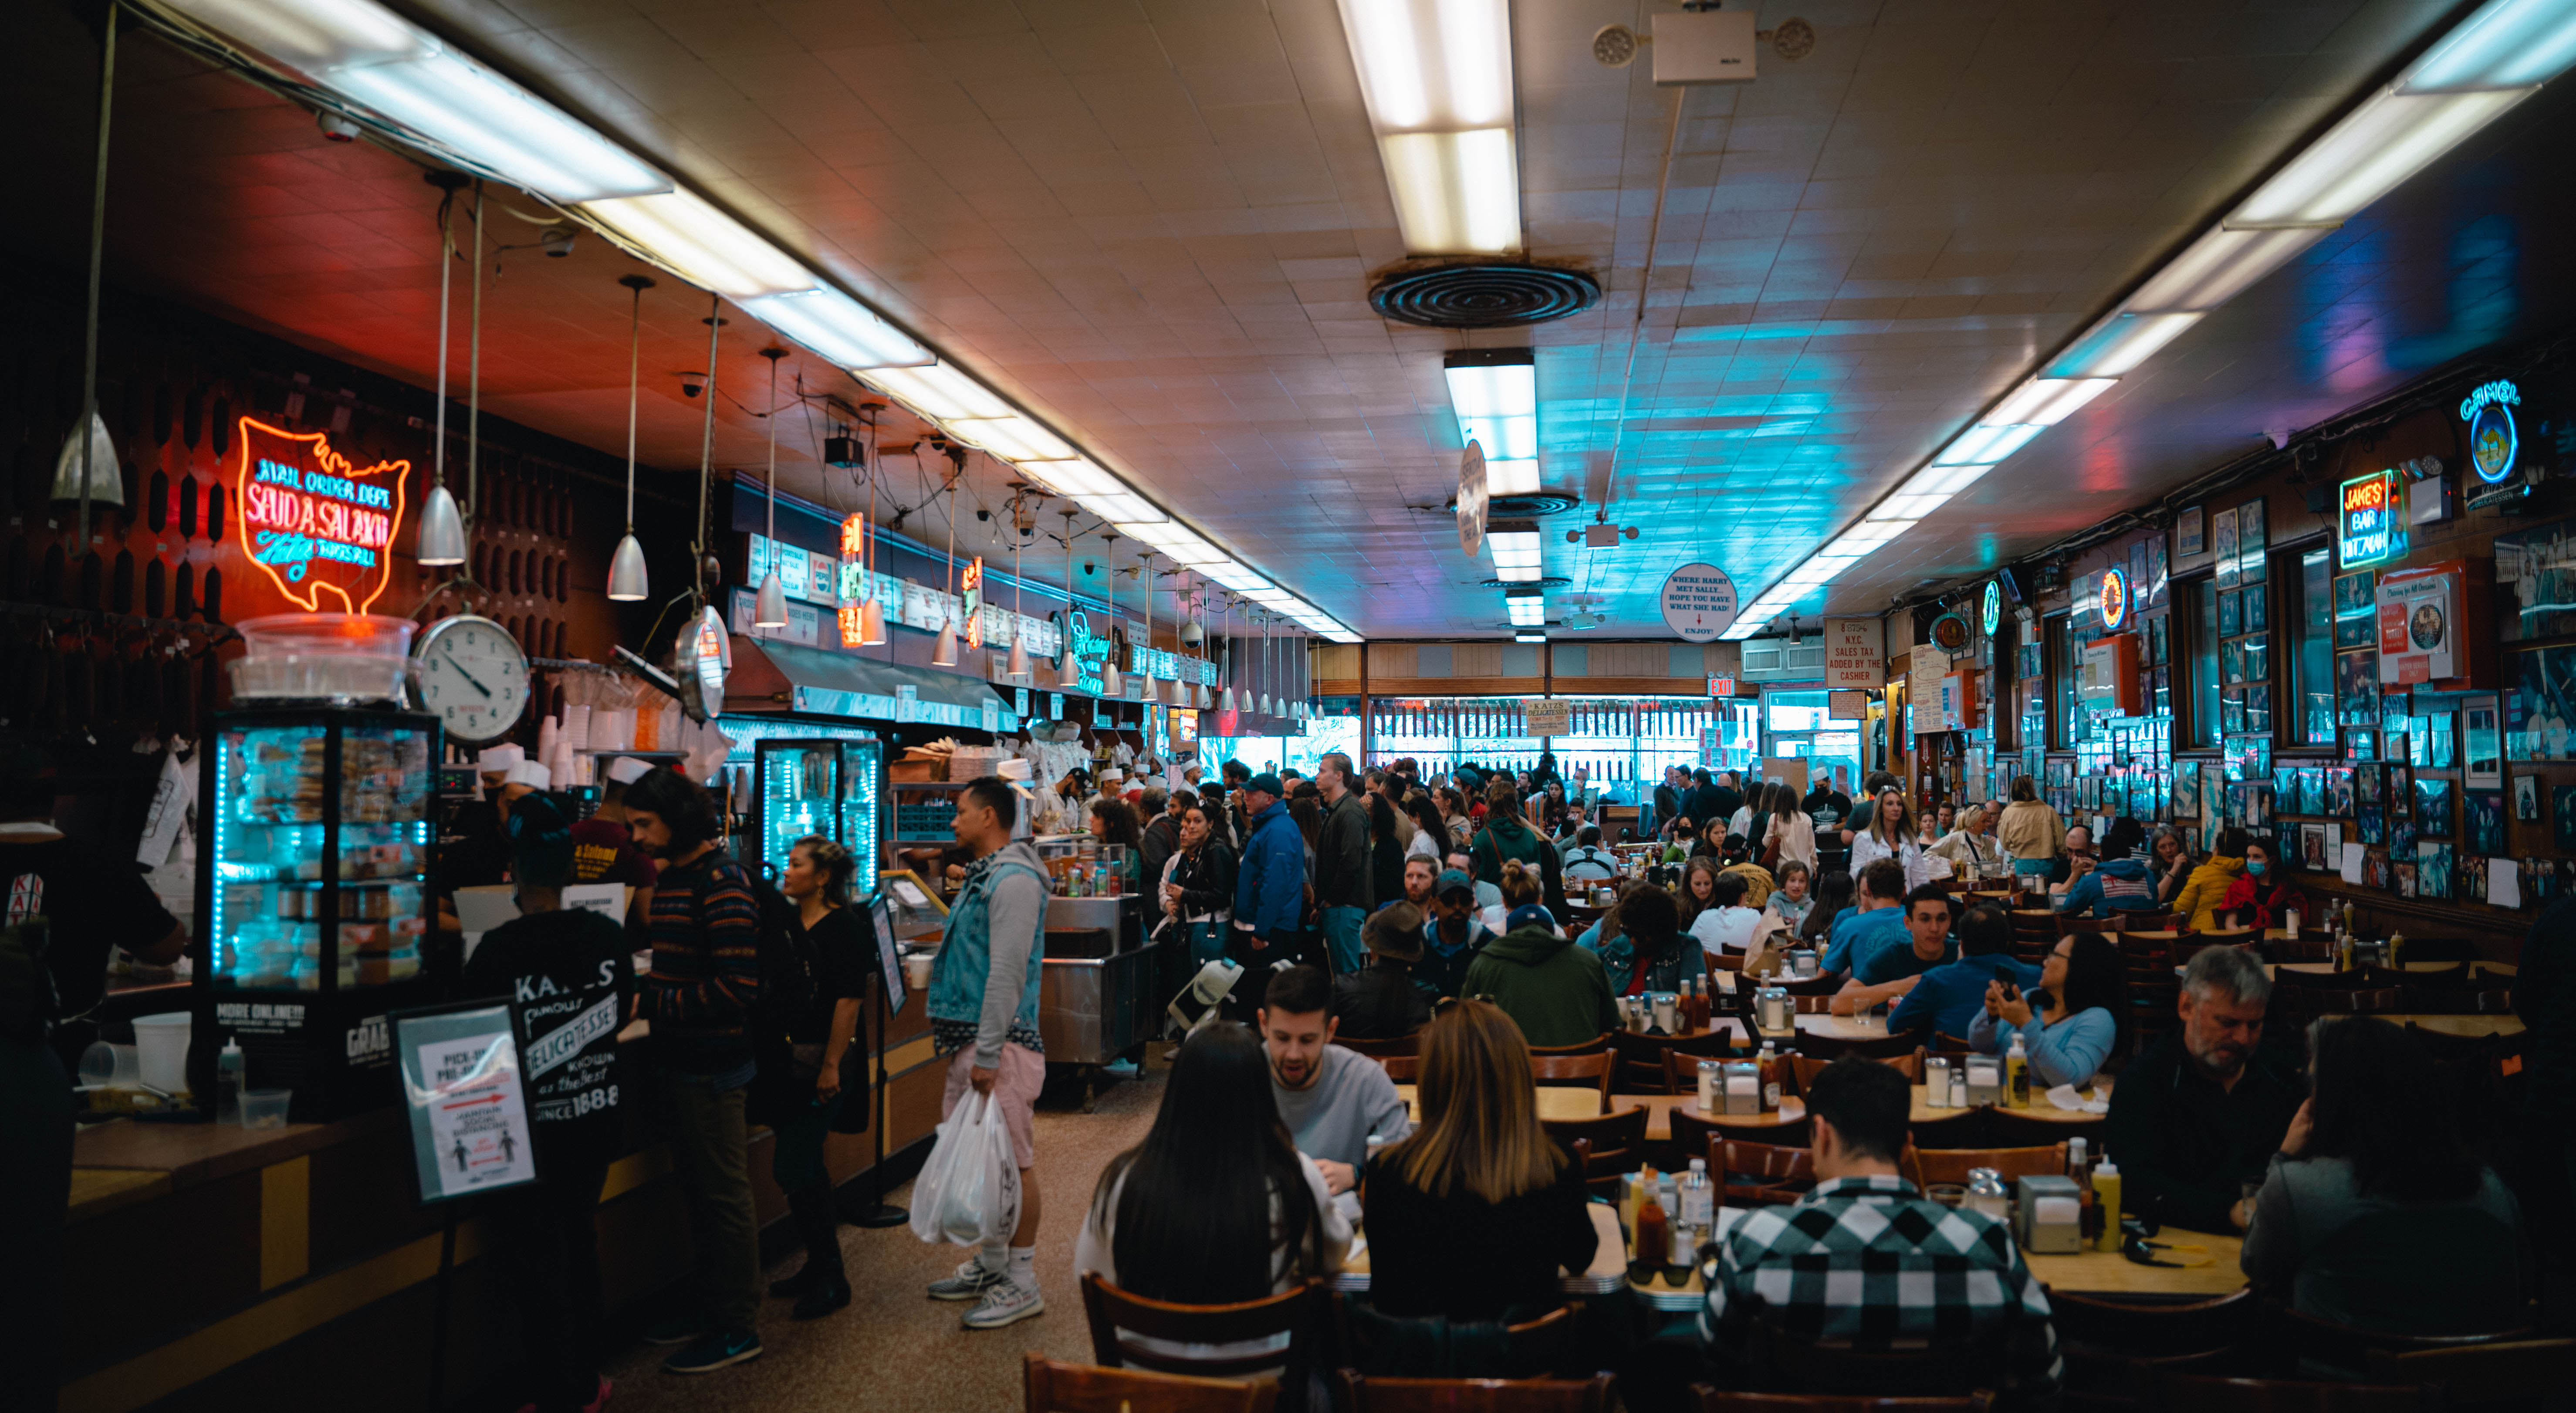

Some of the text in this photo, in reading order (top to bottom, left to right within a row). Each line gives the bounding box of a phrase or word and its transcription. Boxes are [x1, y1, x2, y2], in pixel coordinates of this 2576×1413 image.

[2460, 379, 2521, 421] CAMEL
[304, 472, 355, 501] ORDER
[2474, 491, 2514, 508] DELICATESSEN
[297, 496, 316, 534] A
[2352, 509, 2376, 530] BAR
[815, 571, 830, 582] PEPSI
[738, 596, 756, 609] ORDE
[802, 610, 816, 622] HERE
[1845, 635, 1864, 645] N.Y.C.
[2386, 627, 2403, 639] TURKEY
[1835, 647, 1874, 656] SALES TAX
[1829, 659, 1881, 669] ADDED BY THE
[1840, 671, 1870, 680] CASHIER
[1711, 679, 1732, 695] EXIT
[515, 959, 616, 1003] KAS
[568, 1052, 615, 1073] KNOWN
[572, 1085, 619, 1117] 1888
